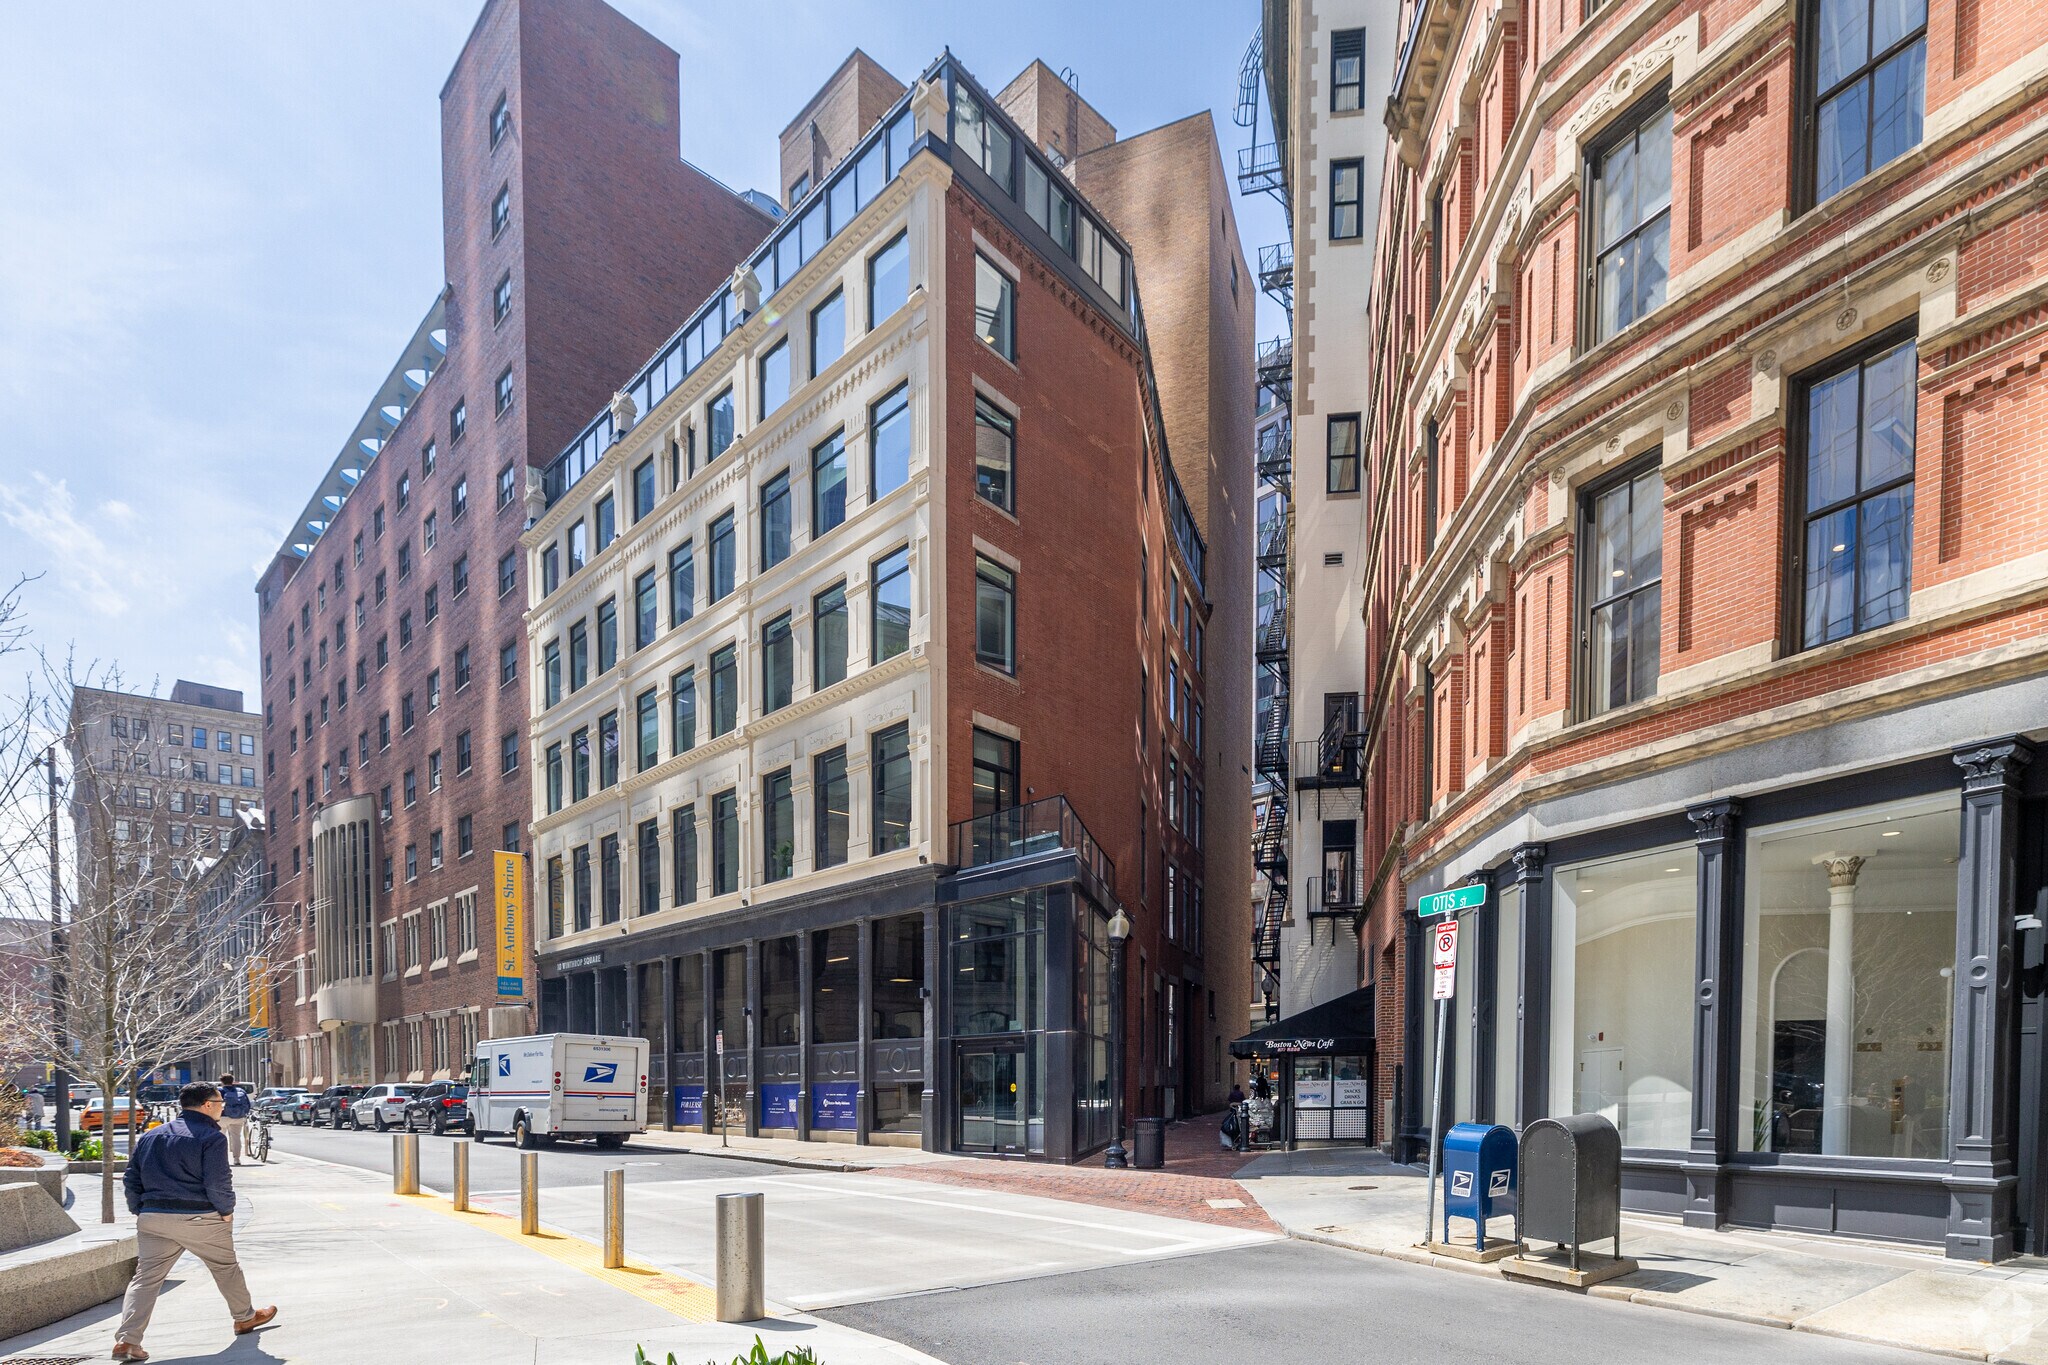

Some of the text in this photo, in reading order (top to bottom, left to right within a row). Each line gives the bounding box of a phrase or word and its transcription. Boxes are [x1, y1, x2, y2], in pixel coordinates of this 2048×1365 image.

[1432, 893, 1455, 912] OTIS
[503, 859, 518, 971] St. Anthony Shrine
[583, 954, 601, 965] SQUARE
[1265, 1040, 1292, 1049] Boston
[1293, 1039, 1316, 1050] News
[1317, 1038, 1335, 1049] Café
